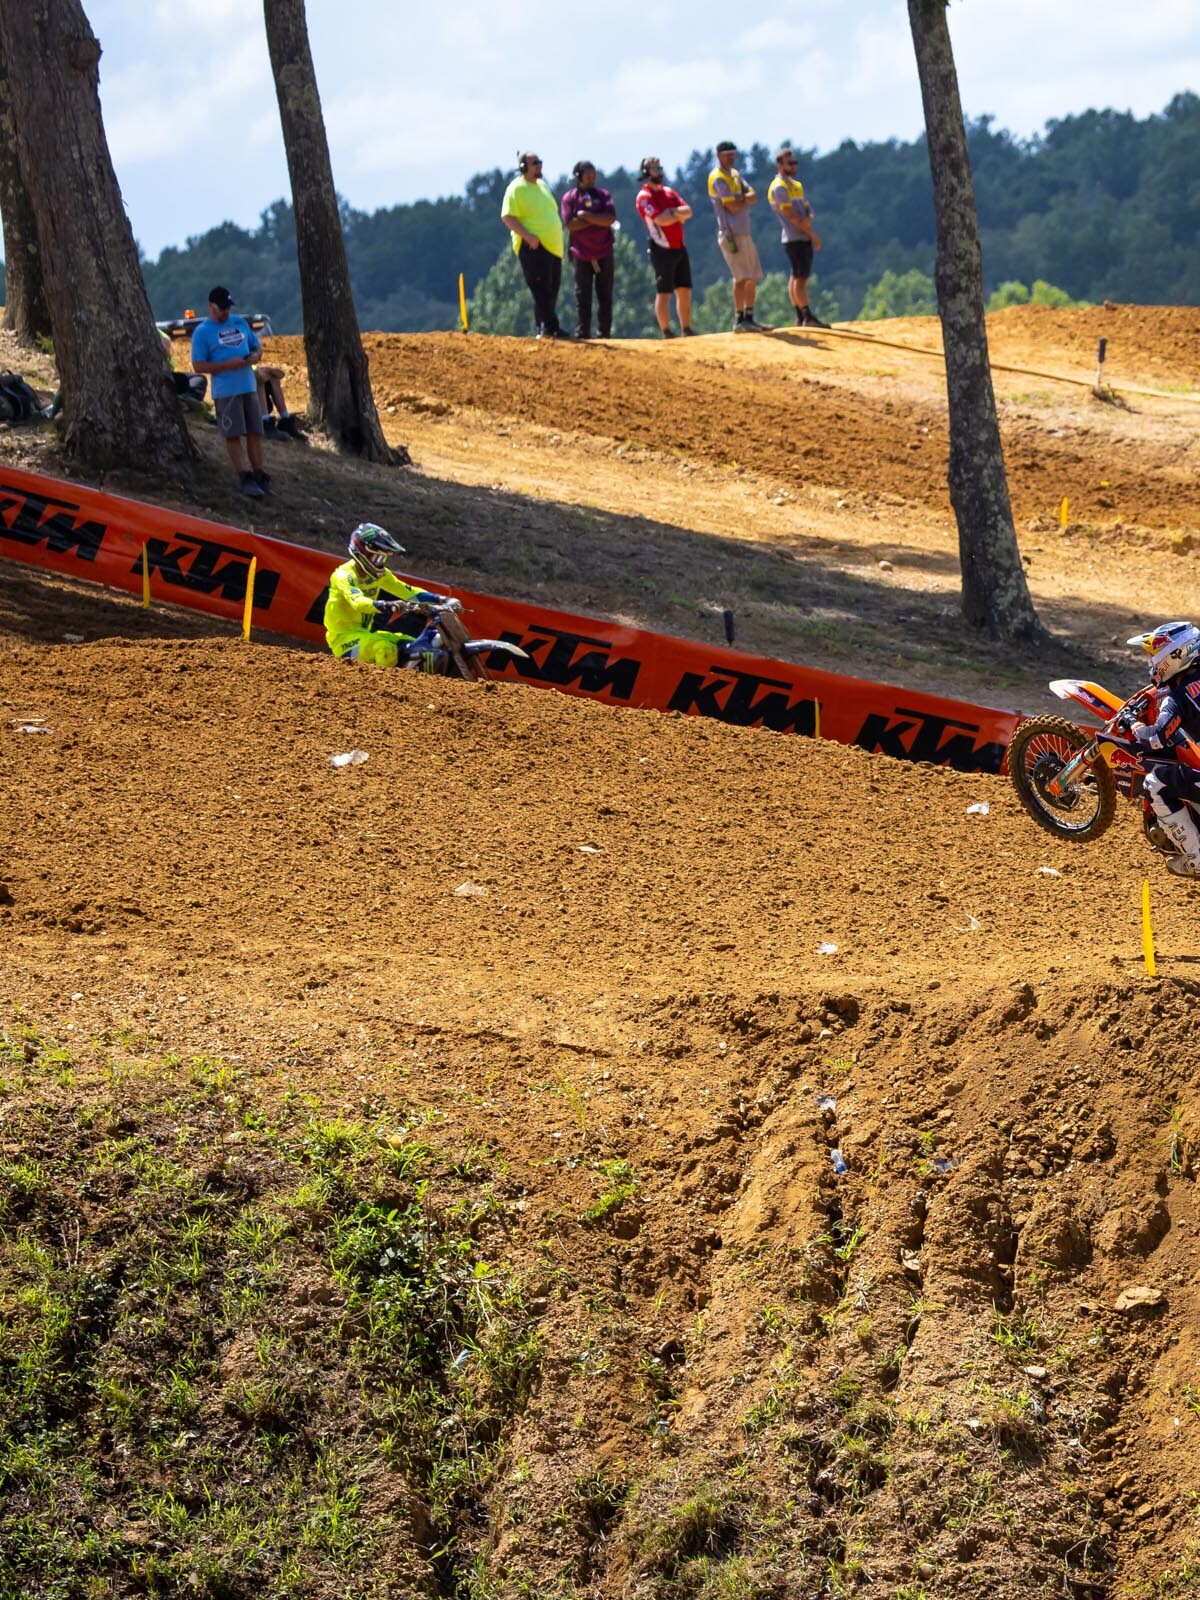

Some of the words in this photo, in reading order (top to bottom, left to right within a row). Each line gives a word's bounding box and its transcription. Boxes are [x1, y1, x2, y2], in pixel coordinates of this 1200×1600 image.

[130, 532, 281, 611] KTM
[485, 624, 642, 700] KTM
[667, 666, 822, 738] KTM
[853, 707, 1007, 775] KTM
